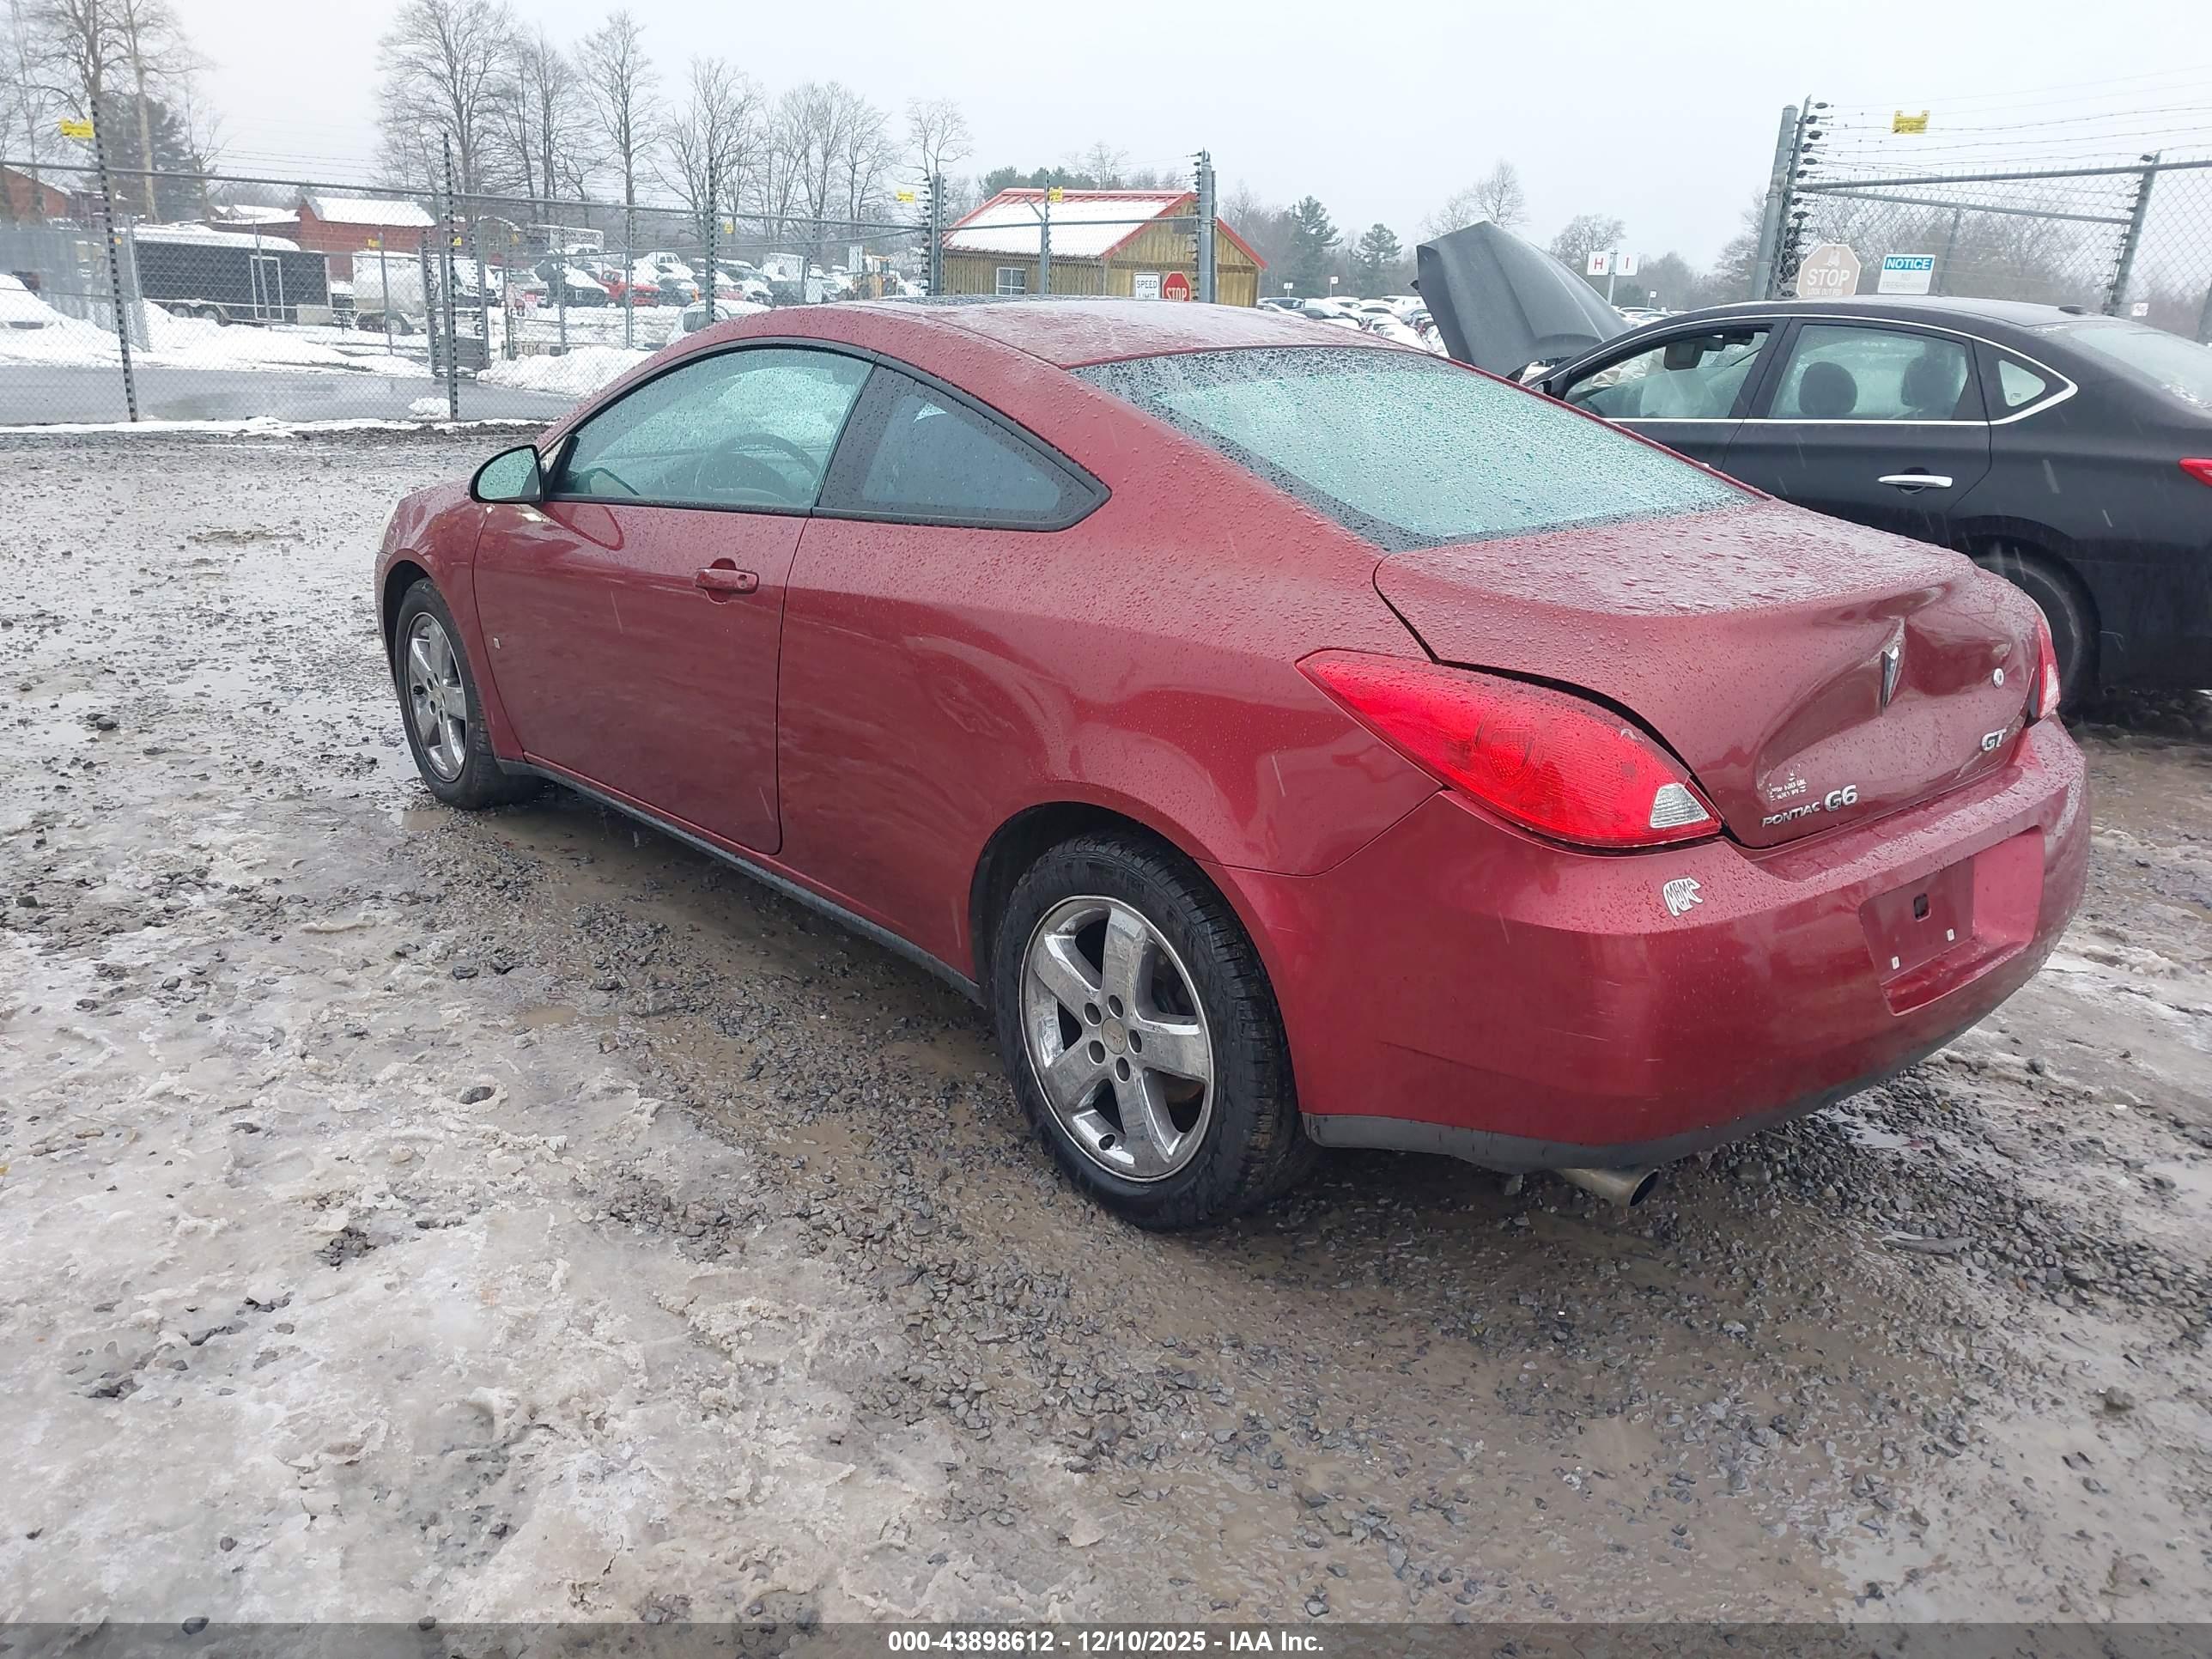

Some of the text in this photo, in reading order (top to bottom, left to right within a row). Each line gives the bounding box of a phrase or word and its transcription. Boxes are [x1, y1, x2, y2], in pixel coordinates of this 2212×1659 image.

[1594, 257, 1604, 270] H
[1887, 258, 1930, 269] NOTICE
[1807, 268, 1850, 286] STOP
[1136, 280, 1158, 289] SPEED
[1166, 287, 1188, 301] STOP
[1982, 728, 2007, 751] GT
[1761, 801, 1820, 828] PONTIAC
[1824, 784, 1858, 811] G6
